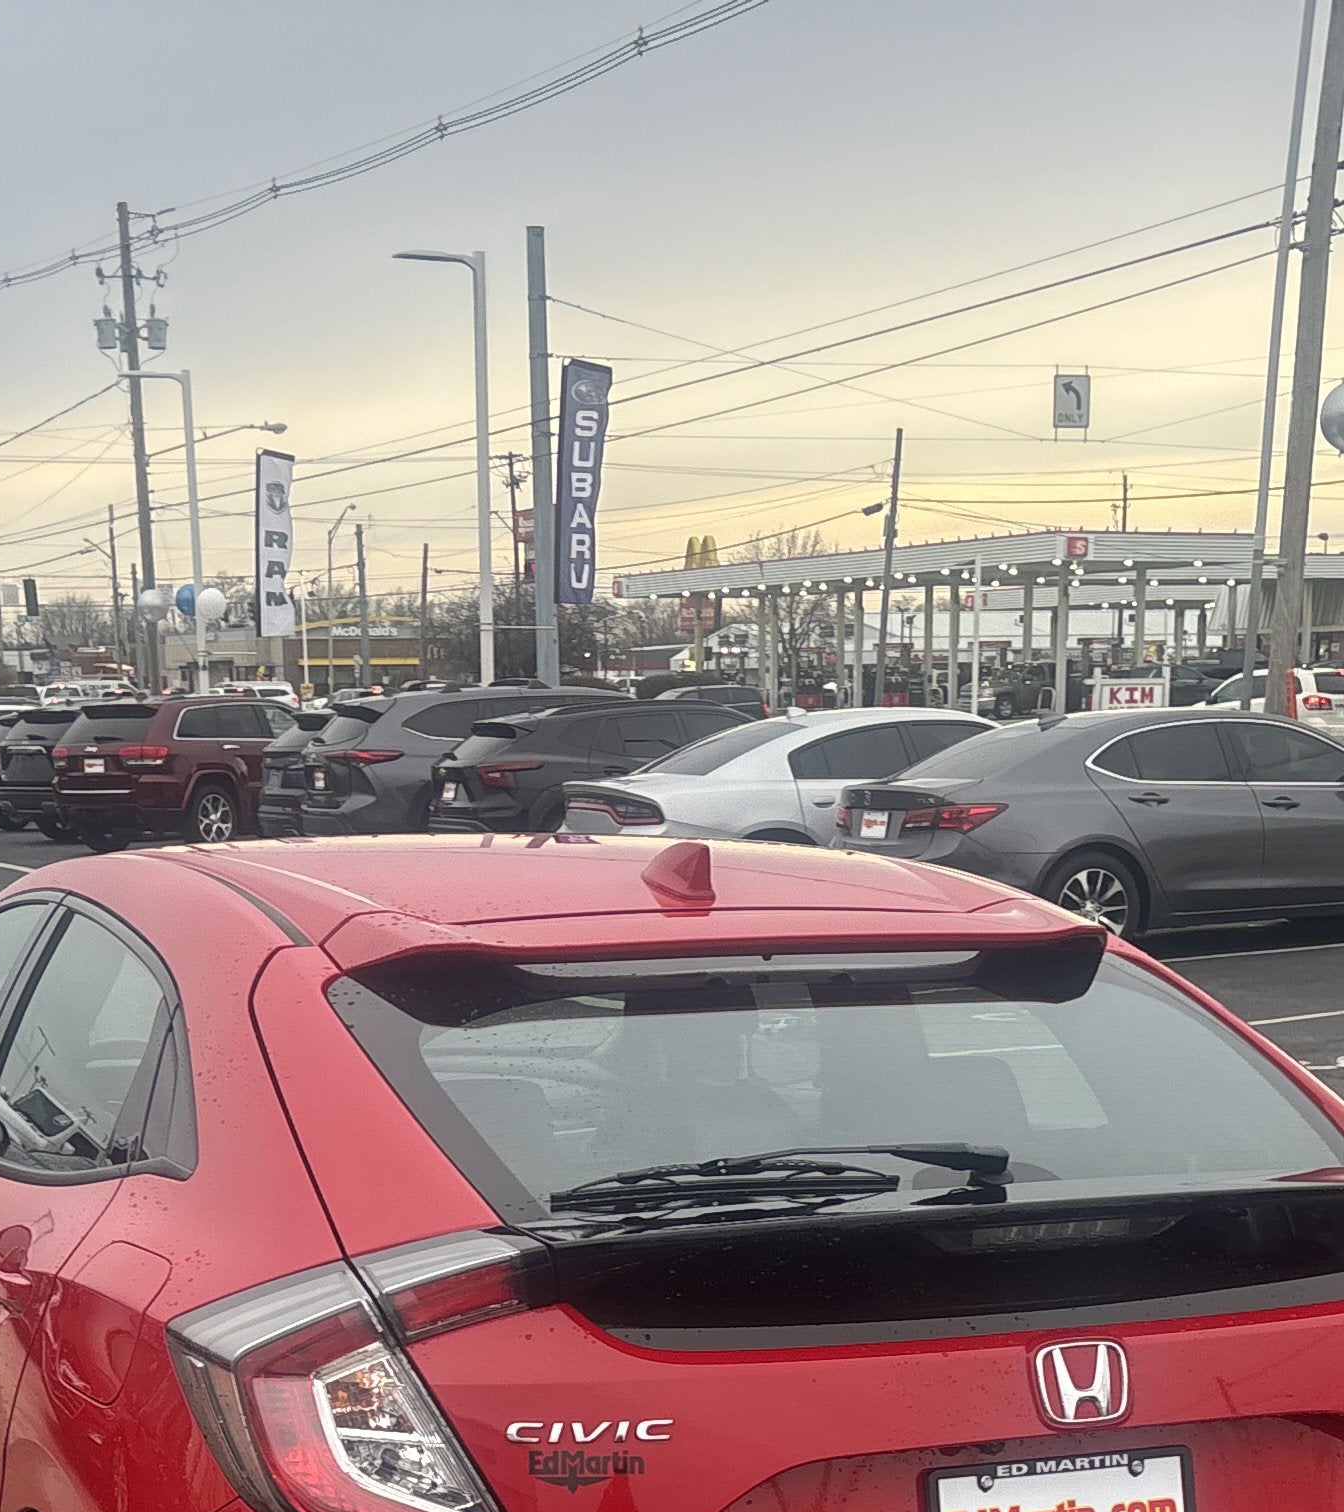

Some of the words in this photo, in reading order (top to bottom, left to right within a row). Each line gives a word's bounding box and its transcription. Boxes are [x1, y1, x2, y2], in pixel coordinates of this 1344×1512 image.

[1057, 412, 1084, 424] ONLY
[569, 409, 600, 590] SUBARU
[263, 529, 289, 607] RAM
[1109, 686, 1154, 704] KIM
[505, 1418, 675, 1444] CIVIC
[527, 1450, 646, 1476] EdMartin
[996, 1463, 1029, 1478] ED
[1035, 1453, 1130, 1474] MARTIN
